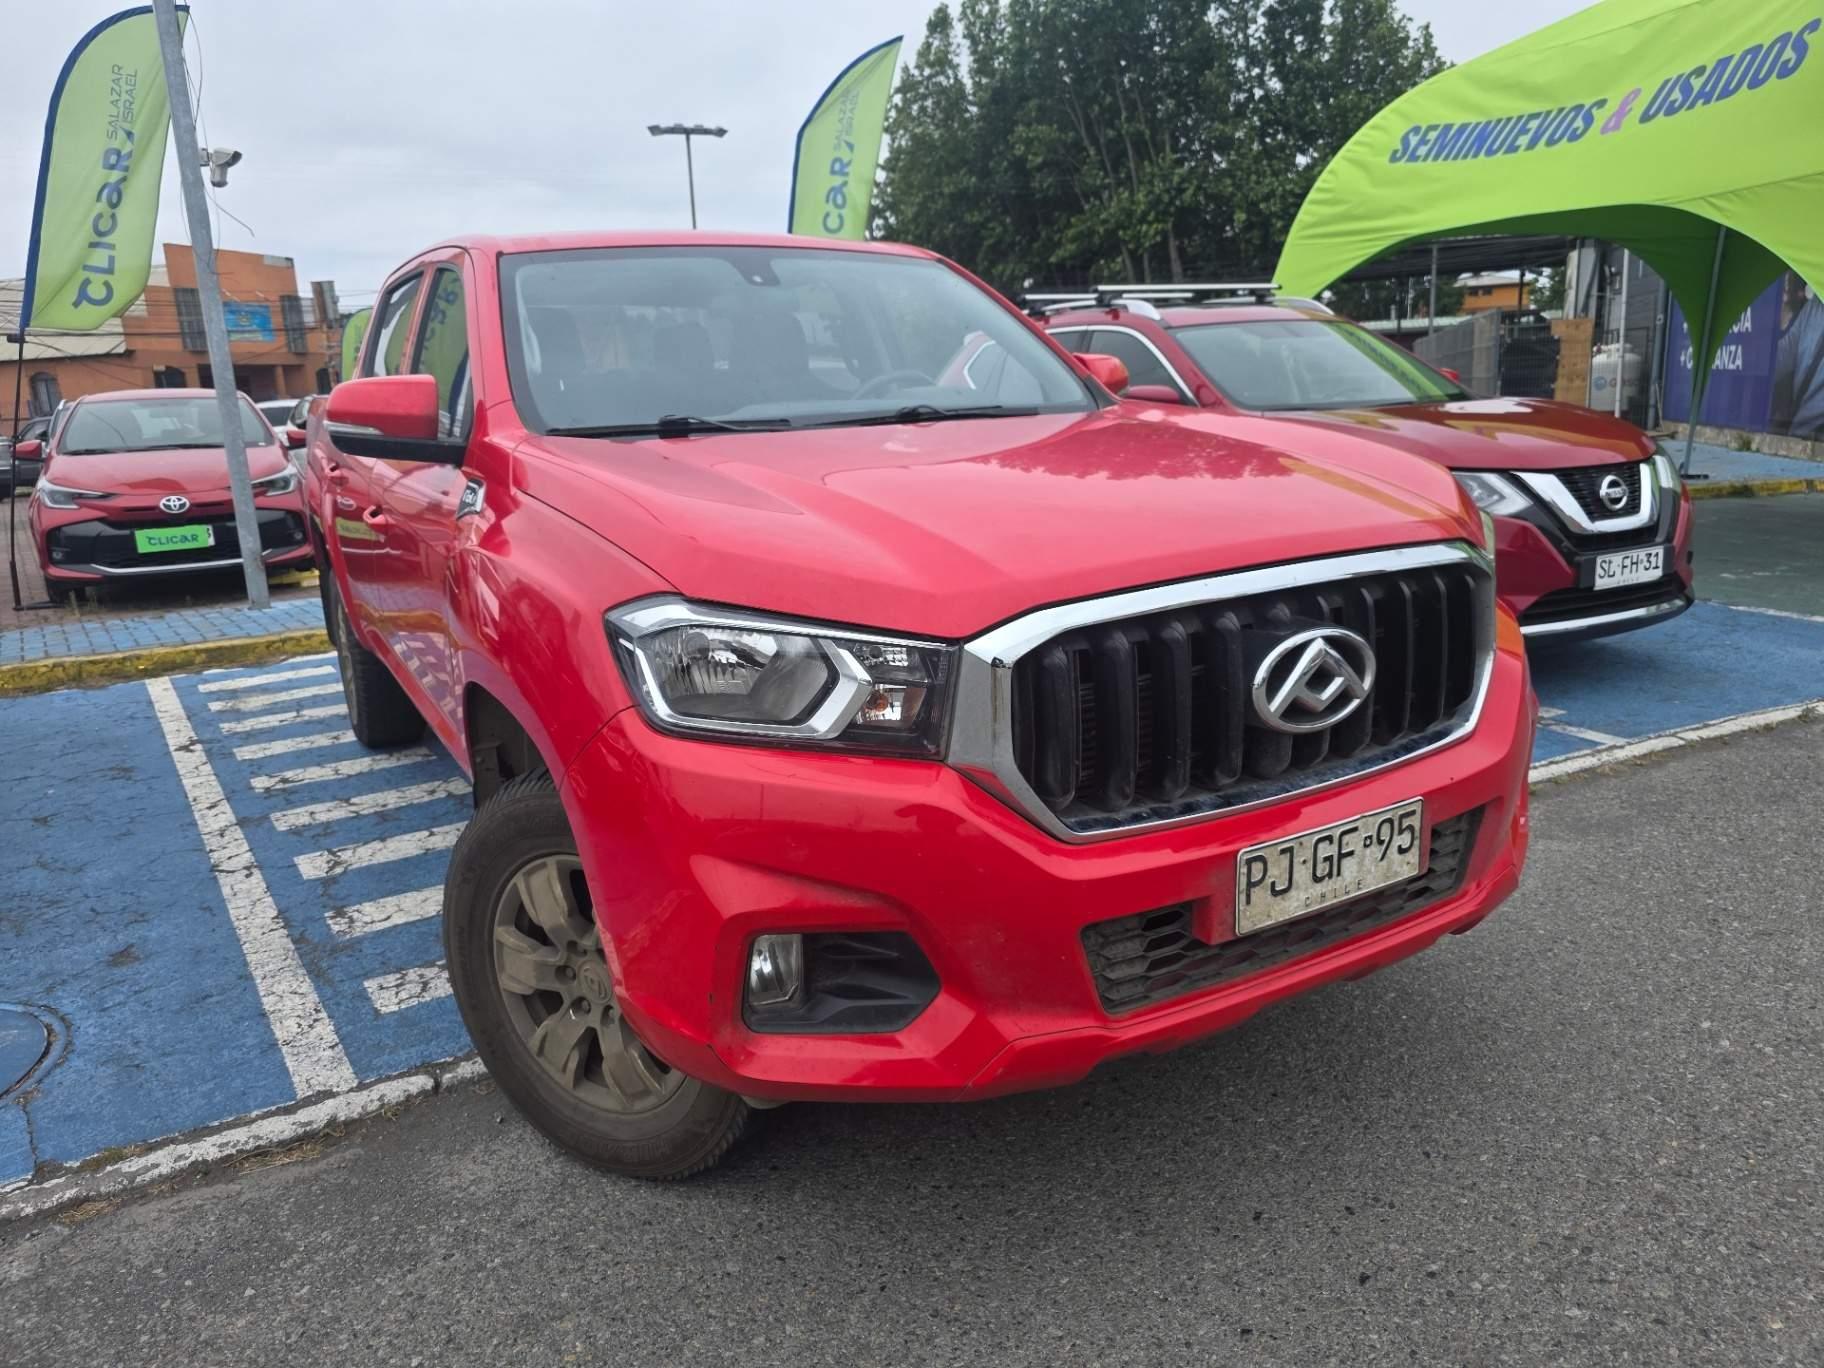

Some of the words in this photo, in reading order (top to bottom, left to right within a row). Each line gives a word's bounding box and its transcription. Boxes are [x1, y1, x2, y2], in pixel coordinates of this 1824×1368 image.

[106, 63, 124, 141] SALAZAR
[121, 68, 138, 124] ISRAEL
[1387, 98, 1608, 164] SEMINUEVOS
[1600, 88, 1642, 135] &
[1638, 17, 1822, 124] USADOS
[1305, 879, 1363, 907] CHILE
